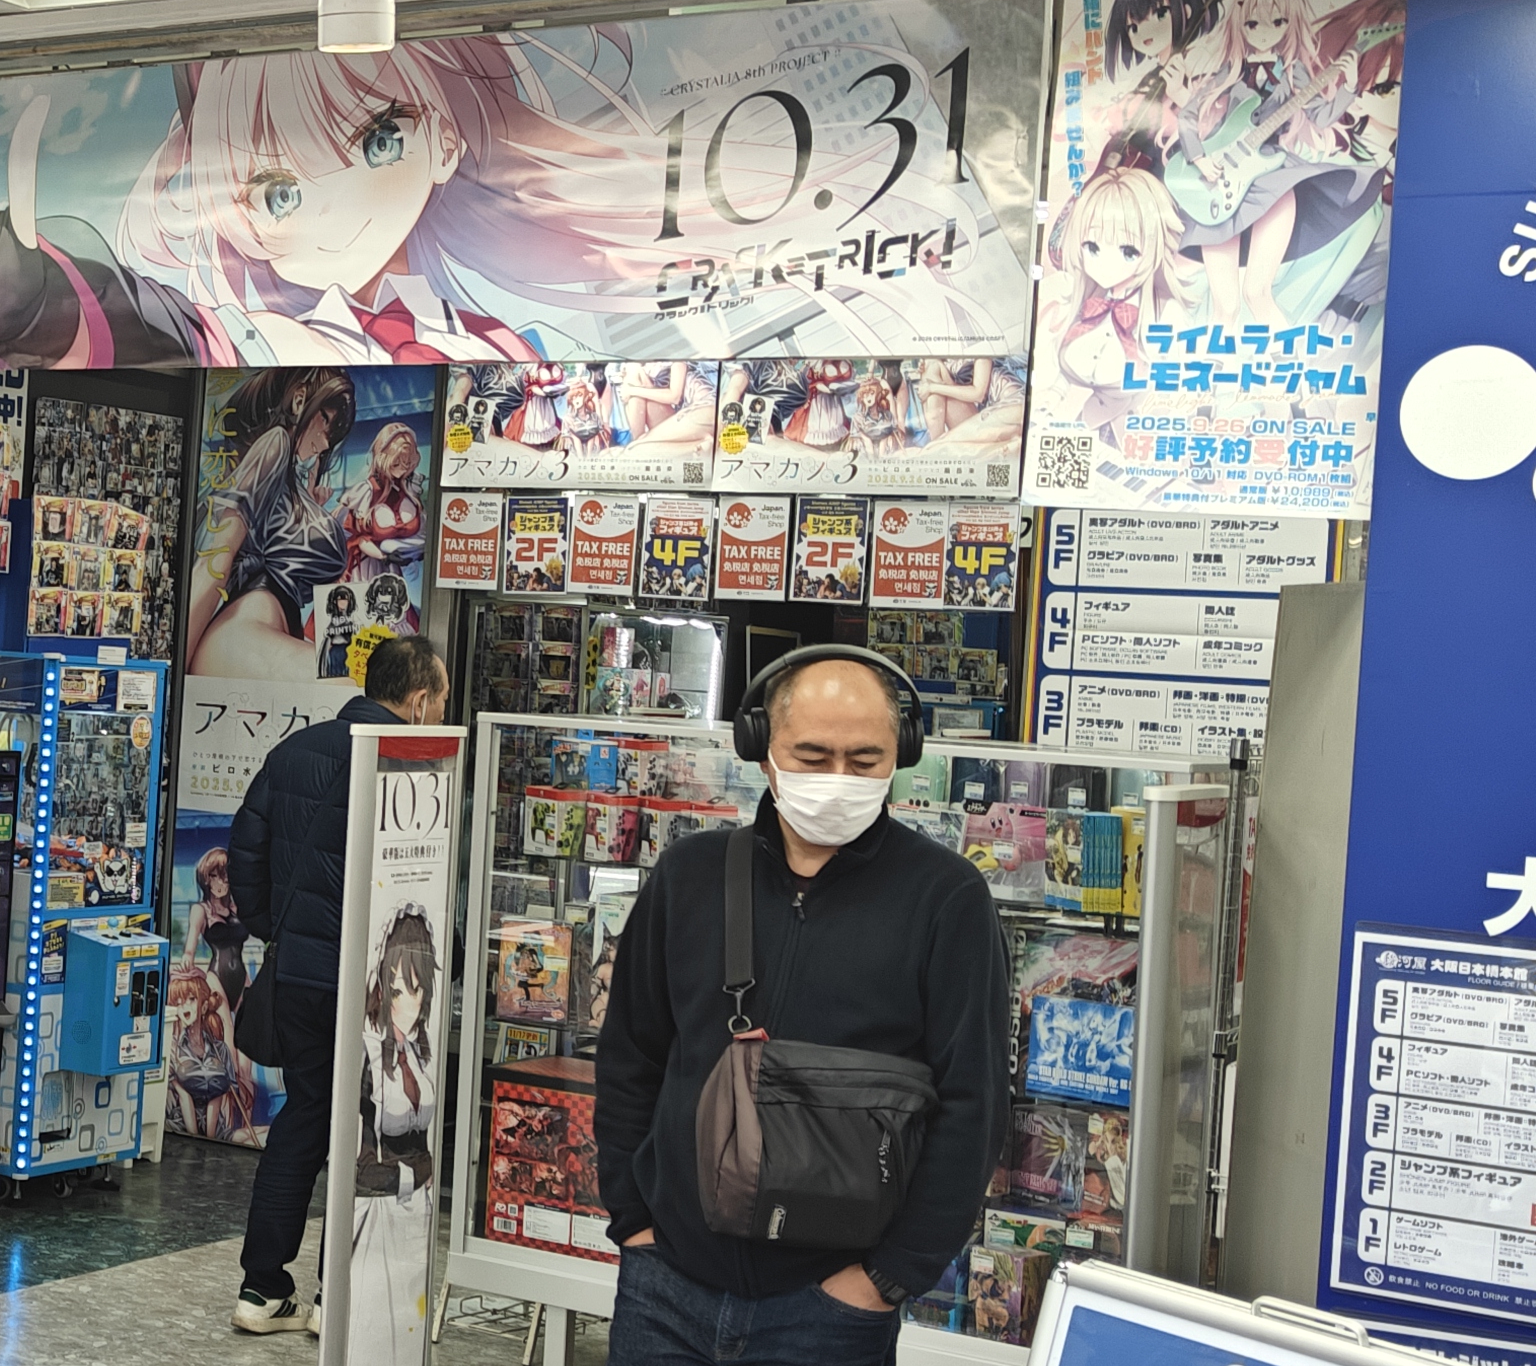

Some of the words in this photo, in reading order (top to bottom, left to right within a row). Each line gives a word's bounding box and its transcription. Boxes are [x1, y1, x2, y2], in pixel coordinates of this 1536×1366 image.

[654, 46, 971, 243] 10.31
[1122, 361, 1368, 396] レモネードジャム
[1125, 415, 1246, 433] 2025.9.26
[1251, 419, 1285, 435] ON
[1293, 421, 1357, 436] SALE
[1123, 435, 1354, 468] 好評予約受付中
[1124, 466, 1179, 479] Windows
[1183, 468, 1222, 481] 10/11
[443, 537, 465, 551] TAX
[468, 538, 495, 553] FREE
[514, 537, 559, 563] 2F
[575, 540, 600, 554] TAX
[602, 541, 631, 556] FREE
[652, 539, 701, 567] 4F
[723, 545, 749, 559] TAX
[750, 546, 782, 560] FREE
[805, 540, 856, 568] 2F
[878, 551, 906, 566] TAX
[907, 552, 940, 567] FREE
[1053, 524, 1076, 570] 5F
[953, 545, 1007, 575] 4F
[1083, 601, 1131, 612] フィギュア
[1049, 606, 1071, 653] 4F
[1042, 690, 1065, 736] 3F
[1075, 717, 1124, 730] プラモデル
[378, 771, 451, 839] 10.31
[1430, 958, 1529, 982] 大阪日本橋本館
[1379, 988, 1400, 1025] 5F
[1375, 1045, 1396, 1082] 4F
[1373, 1103, 1392, 1139] 3F
[1368, 1160, 1387, 1196] 2F
[1364, 1217, 1382, 1253] 1F
[1425, 1281, 1439, 1291] NO
[1440, 1283, 1465, 1295] FOOD
[1467, 1288, 1481, 1298] OR
[1482, 1291, 1510, 1303] DRINK
